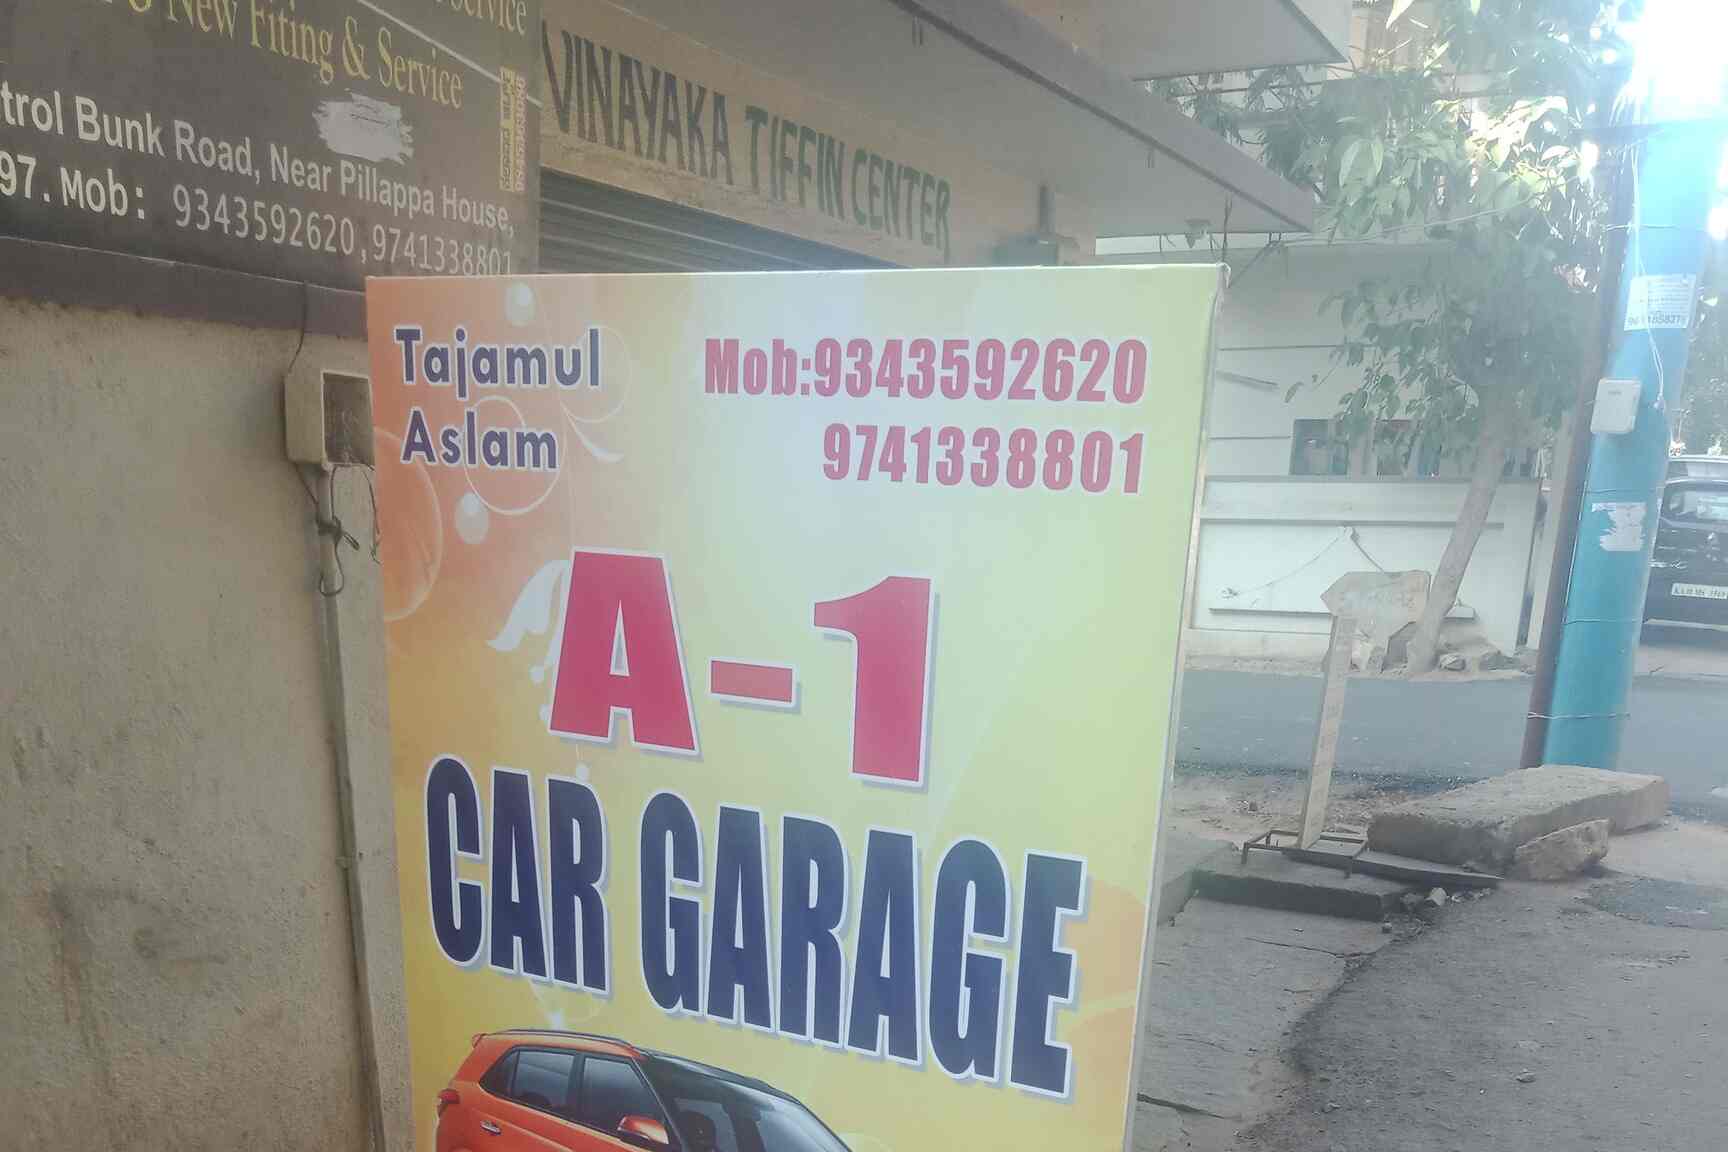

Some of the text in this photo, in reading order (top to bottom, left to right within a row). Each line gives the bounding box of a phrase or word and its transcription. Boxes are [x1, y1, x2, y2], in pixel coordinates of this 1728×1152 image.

[341, 16, 367, 80] &
[377, 27, 463, 109] Service
[75, 95, 165, 158] Bunk
[175, 120, 260, 184] Road,
[270, 143, 332, 190] Near
[340, 160, 435, 220] Pillappa
[442, 185, 515, 238] House,
[541, 20, 734, 186] VINAYAKA
[744, 104, 847, 222] TIFFIN
[851, 148, 952, 260] CENTER
[395, 327, 1148, 404] Tajamul Mob:9343592620
[401, 408, 558, 470] Aslam
[823, 423, 1144, 495] 9741338801
[425, 754, 1087, 1097] CAR GARAGE
